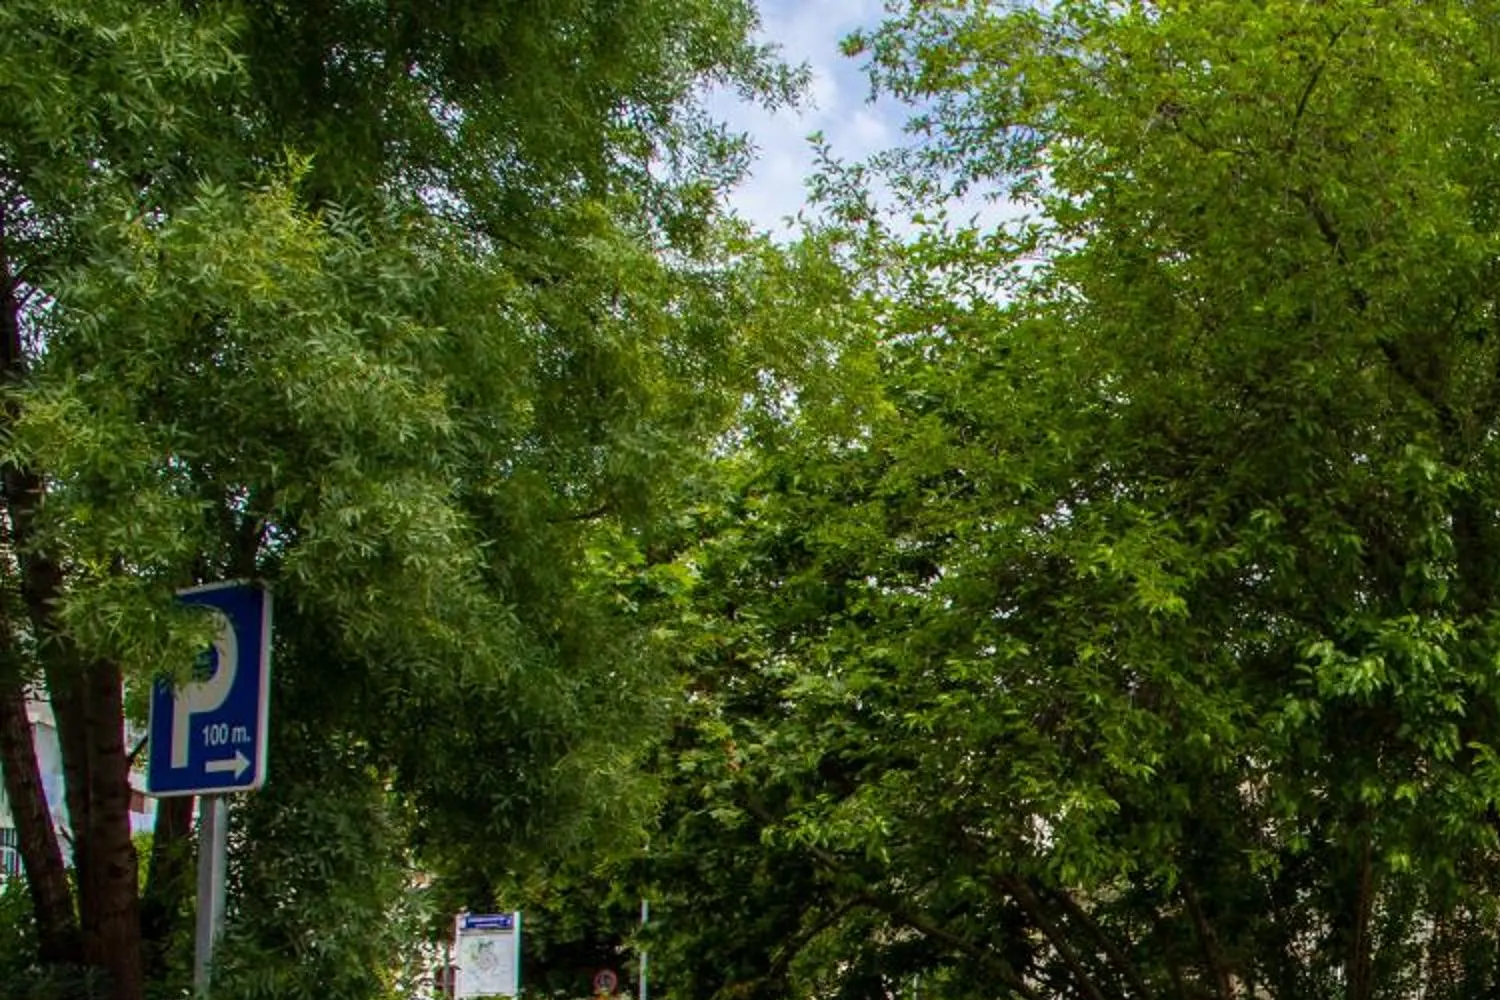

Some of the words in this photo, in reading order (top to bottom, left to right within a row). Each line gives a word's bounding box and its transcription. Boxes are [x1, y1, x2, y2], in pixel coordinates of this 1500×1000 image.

[171, 604, 239, 768] P
[203, 723, 229, 747] 100
[231, 728, 252, 744] m.
